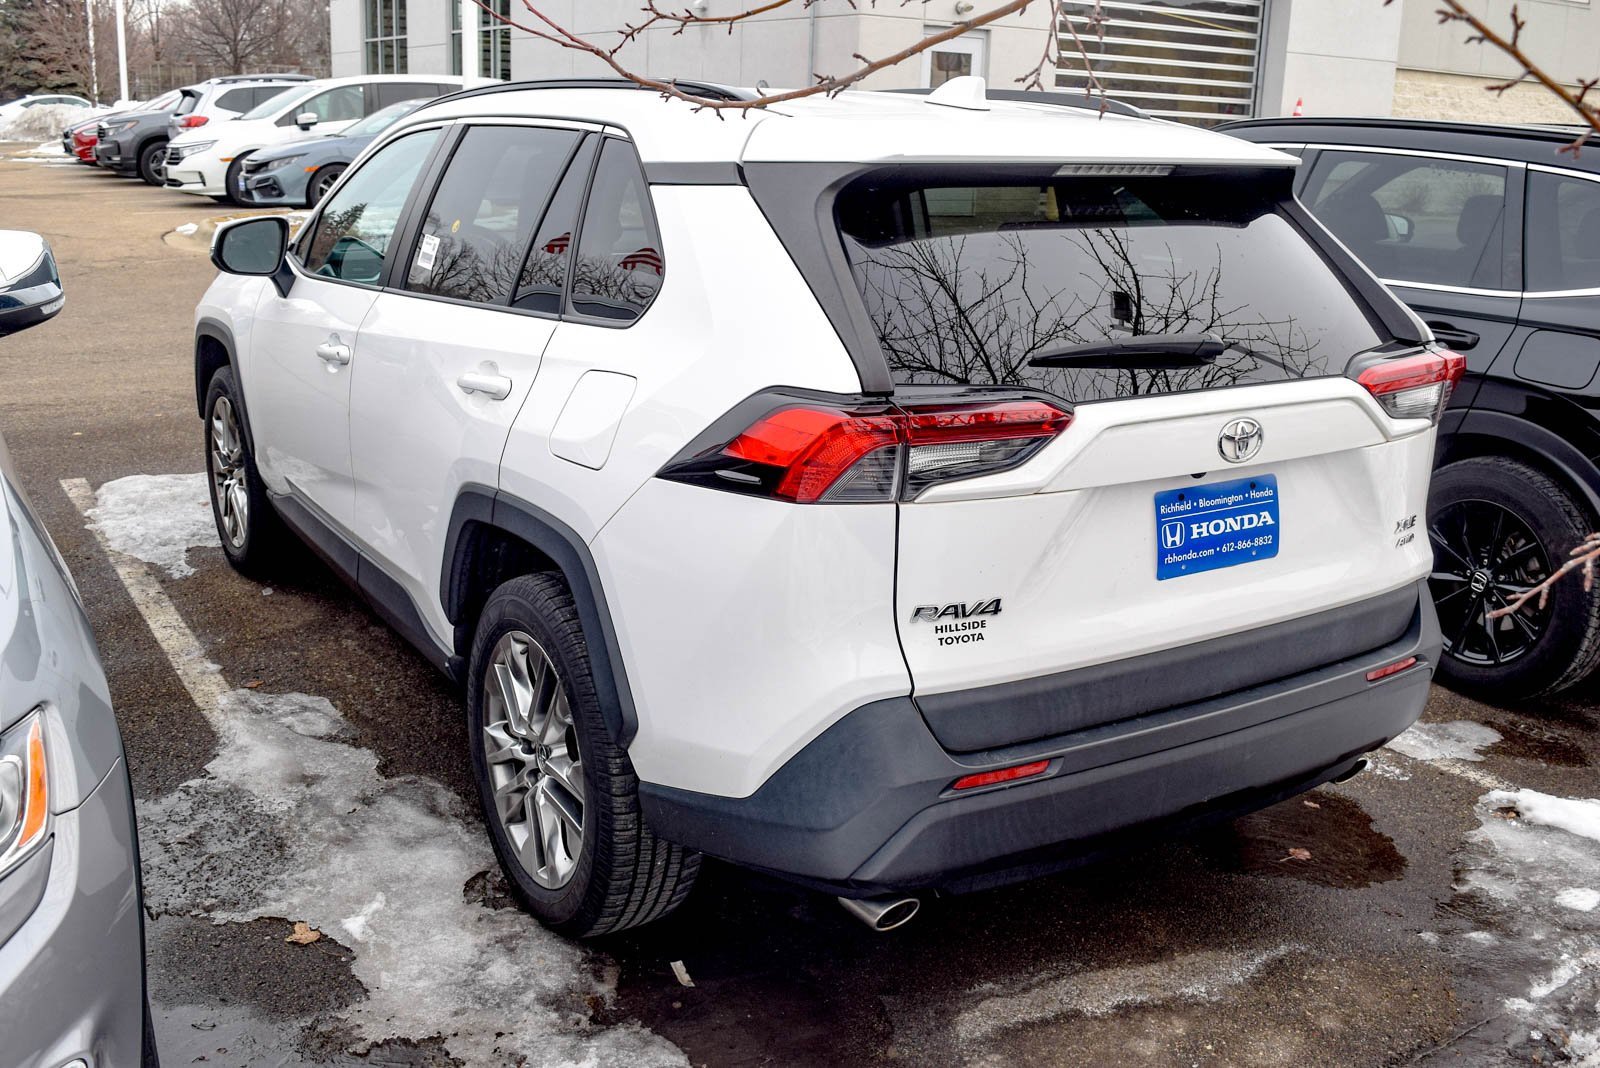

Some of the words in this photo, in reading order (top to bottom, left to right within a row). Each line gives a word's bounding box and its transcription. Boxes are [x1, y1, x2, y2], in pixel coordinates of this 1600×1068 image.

[1160, 500, 1192, 514] Richfield
[1198, 494, 1243, 508] Bloomington
[1250, 487, 1273, 499] Honda
[1190, 511, 1275, 539] HONDA
[1164, 548, 1215, 565] rbhonda.com
[1221, 535, 1273, 553] 612-866-8832
[909, 597, 1003, 624] RAV4
[935, 620, 987, 634] HILLSIDE
[938, 632, 985, 646] TOYOTA
